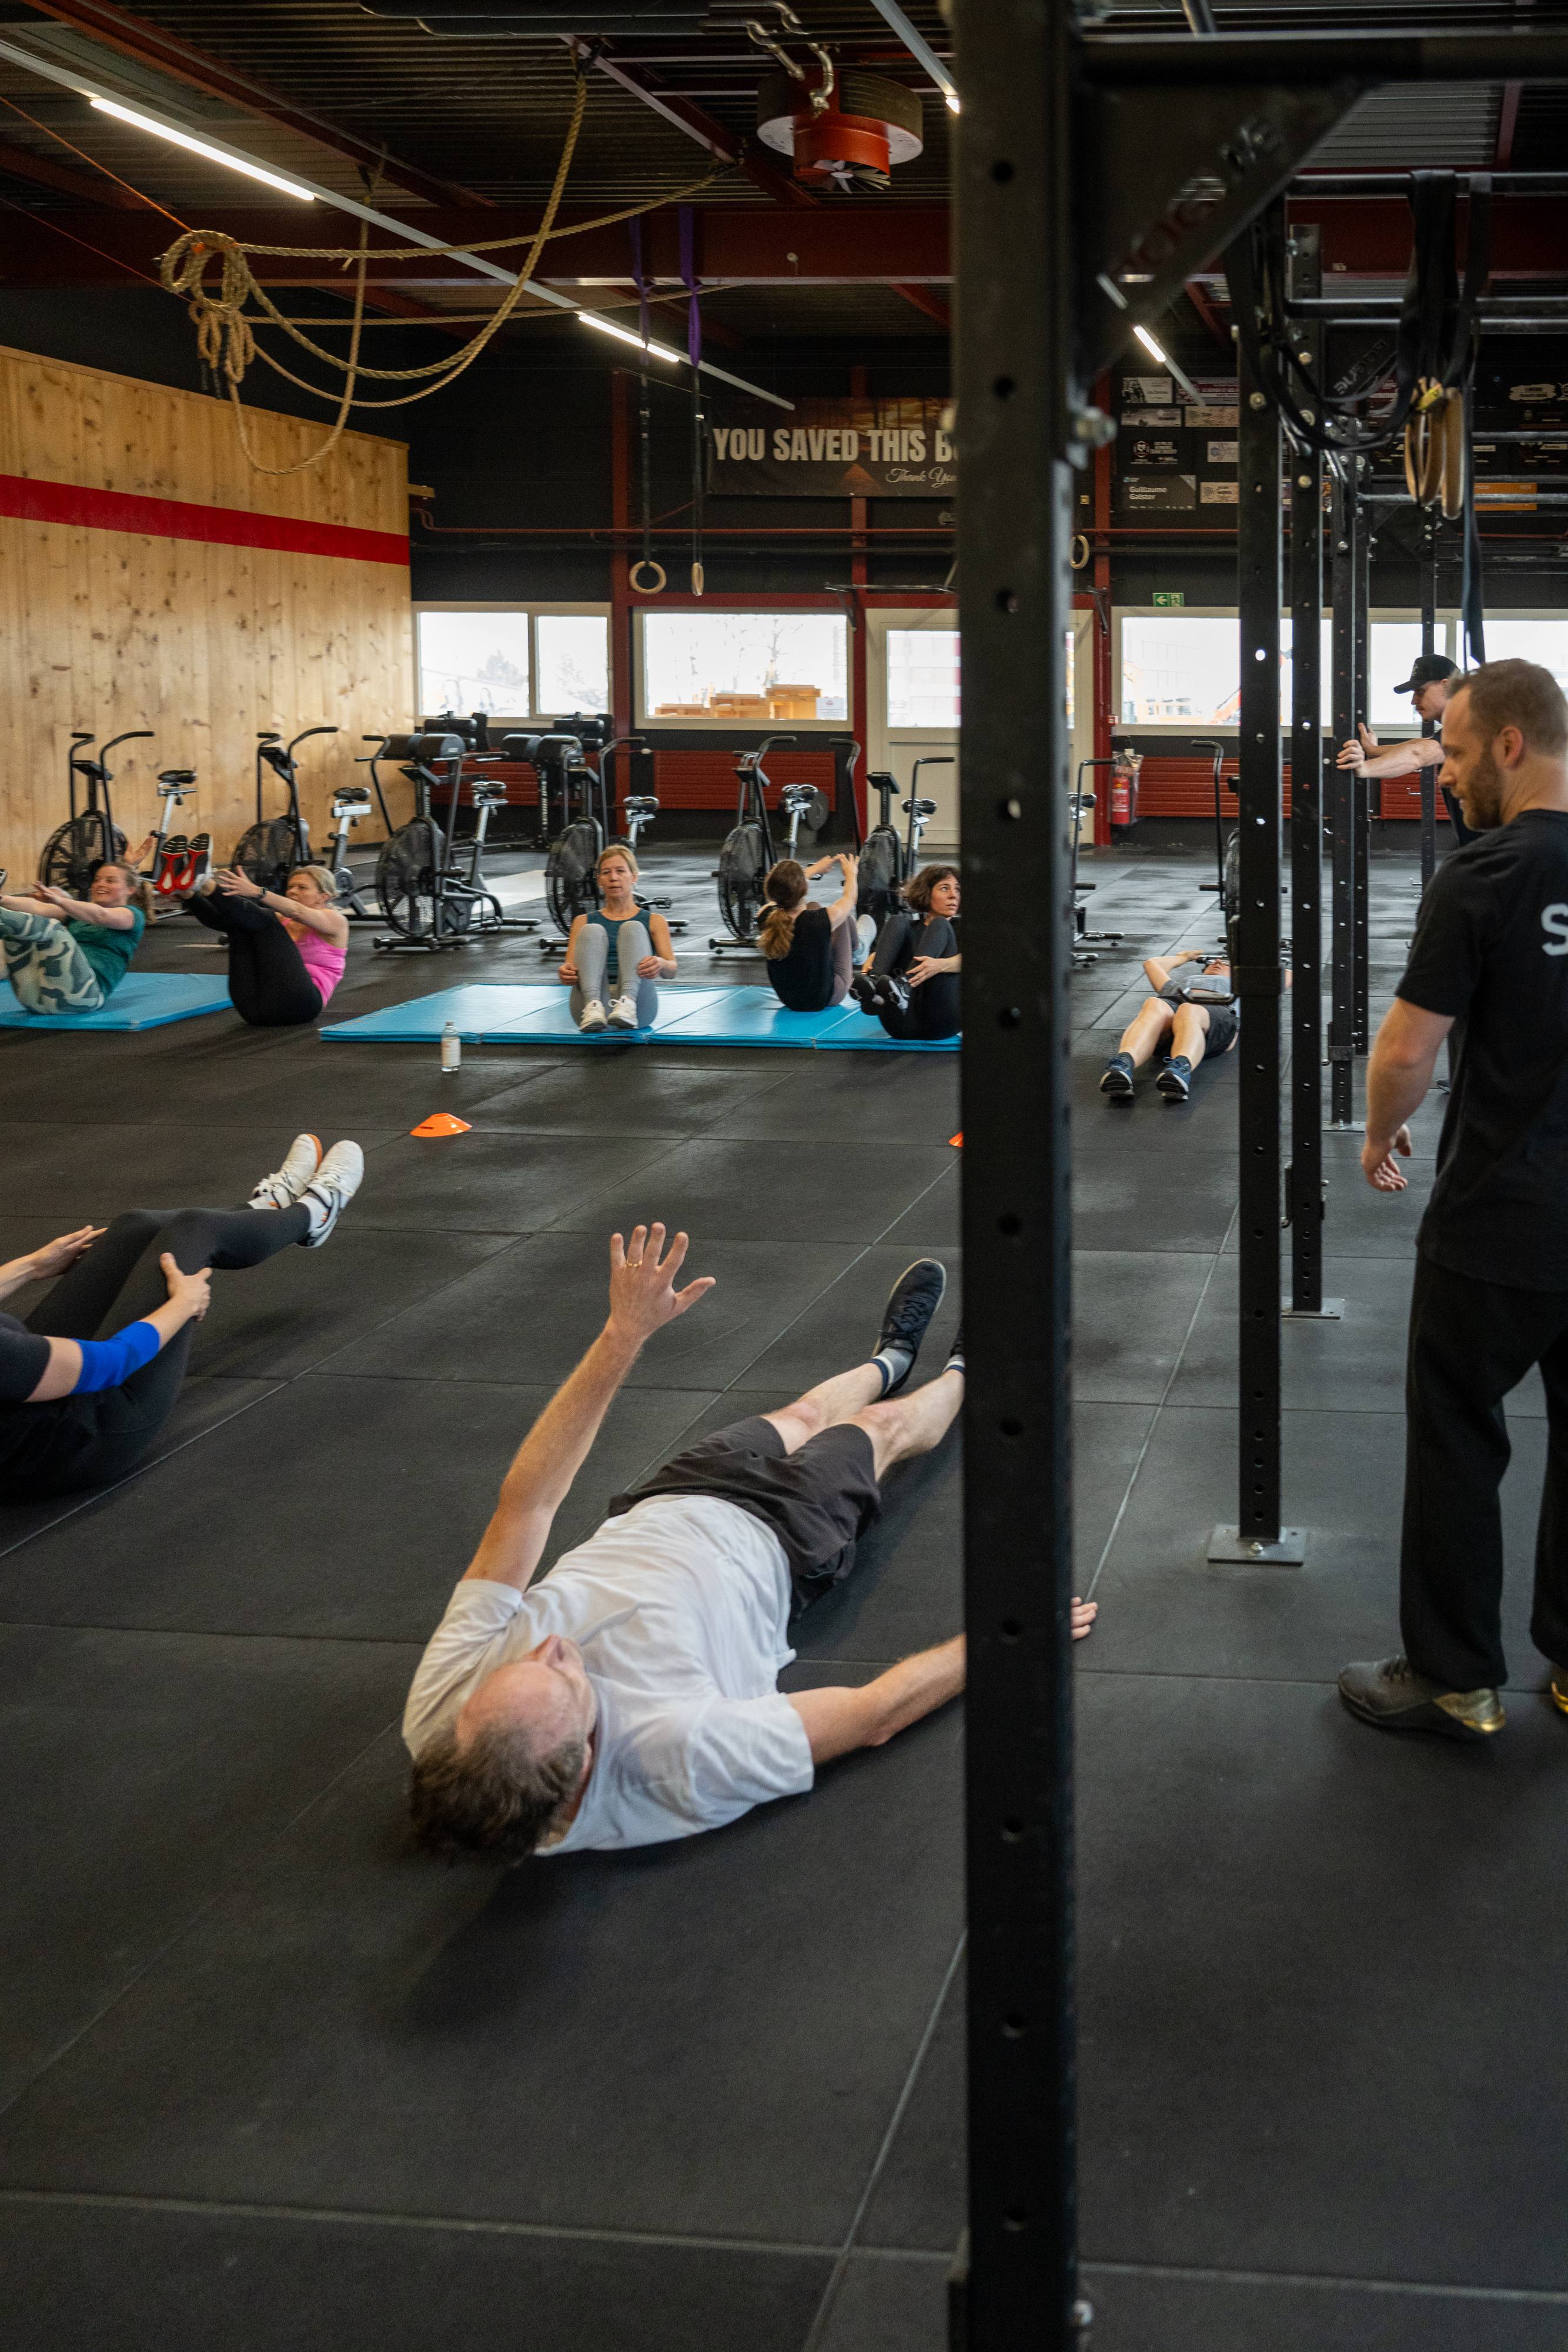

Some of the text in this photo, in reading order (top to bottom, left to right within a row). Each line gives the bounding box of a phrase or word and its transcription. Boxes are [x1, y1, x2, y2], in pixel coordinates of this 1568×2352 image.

[713, 428, 765, 460] YOU
[773, 429, 859, 461] SAVED
[868, 429, 927, 462] THIS
[885, 469, 926, 483] Thank
